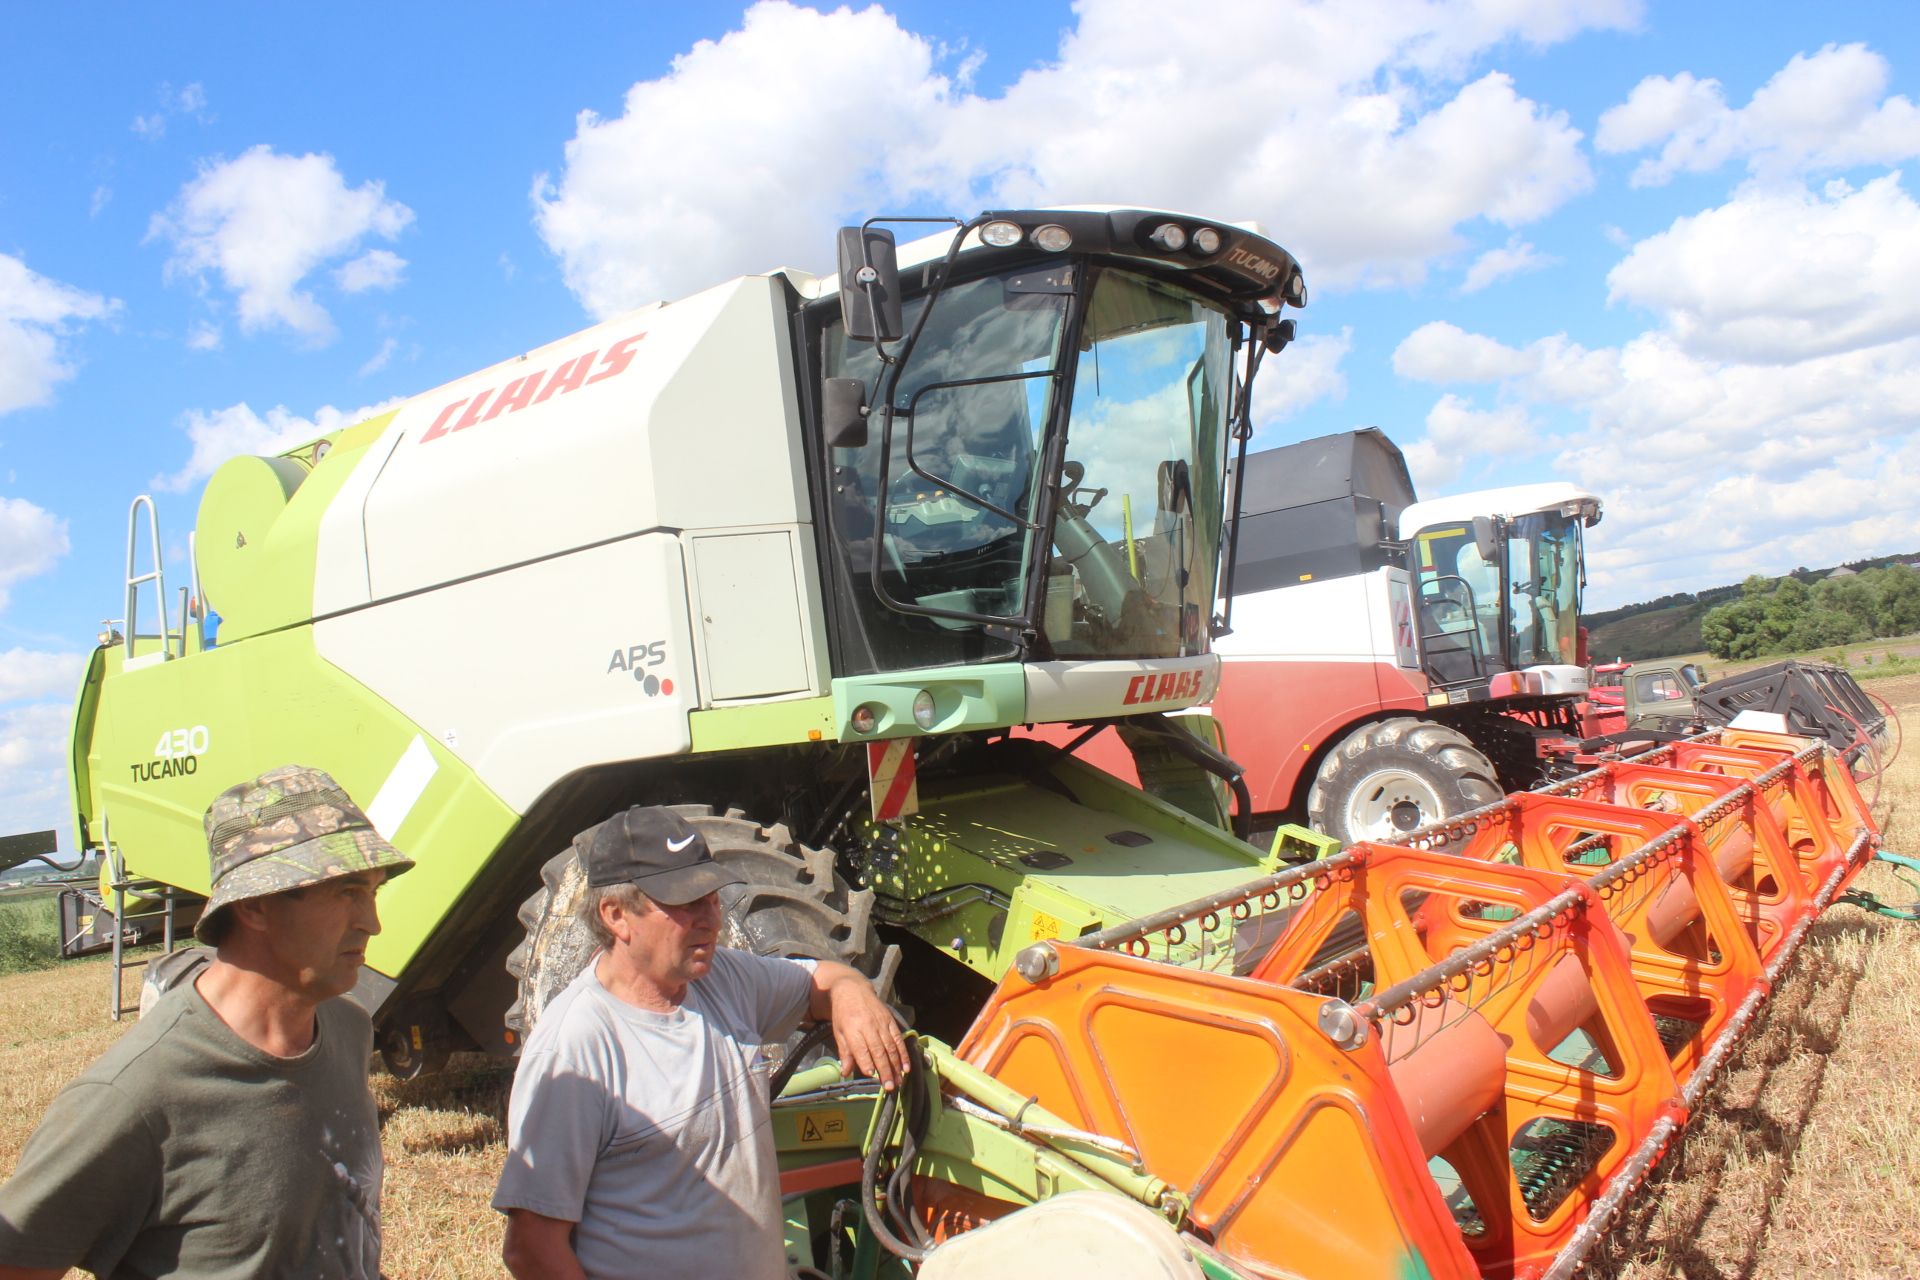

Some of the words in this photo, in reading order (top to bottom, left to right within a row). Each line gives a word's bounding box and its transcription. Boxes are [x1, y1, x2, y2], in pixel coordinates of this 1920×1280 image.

[1228, 247, 1279, 279] TUCANO
[419, 331, 648, 444] CLAAS
[607, 640, 666, 674] APS
[1123, 670, 1203, 704] CLAAS
[154, 724, 209, 760] 430
[130, 755, 197, 783] TUCANO
